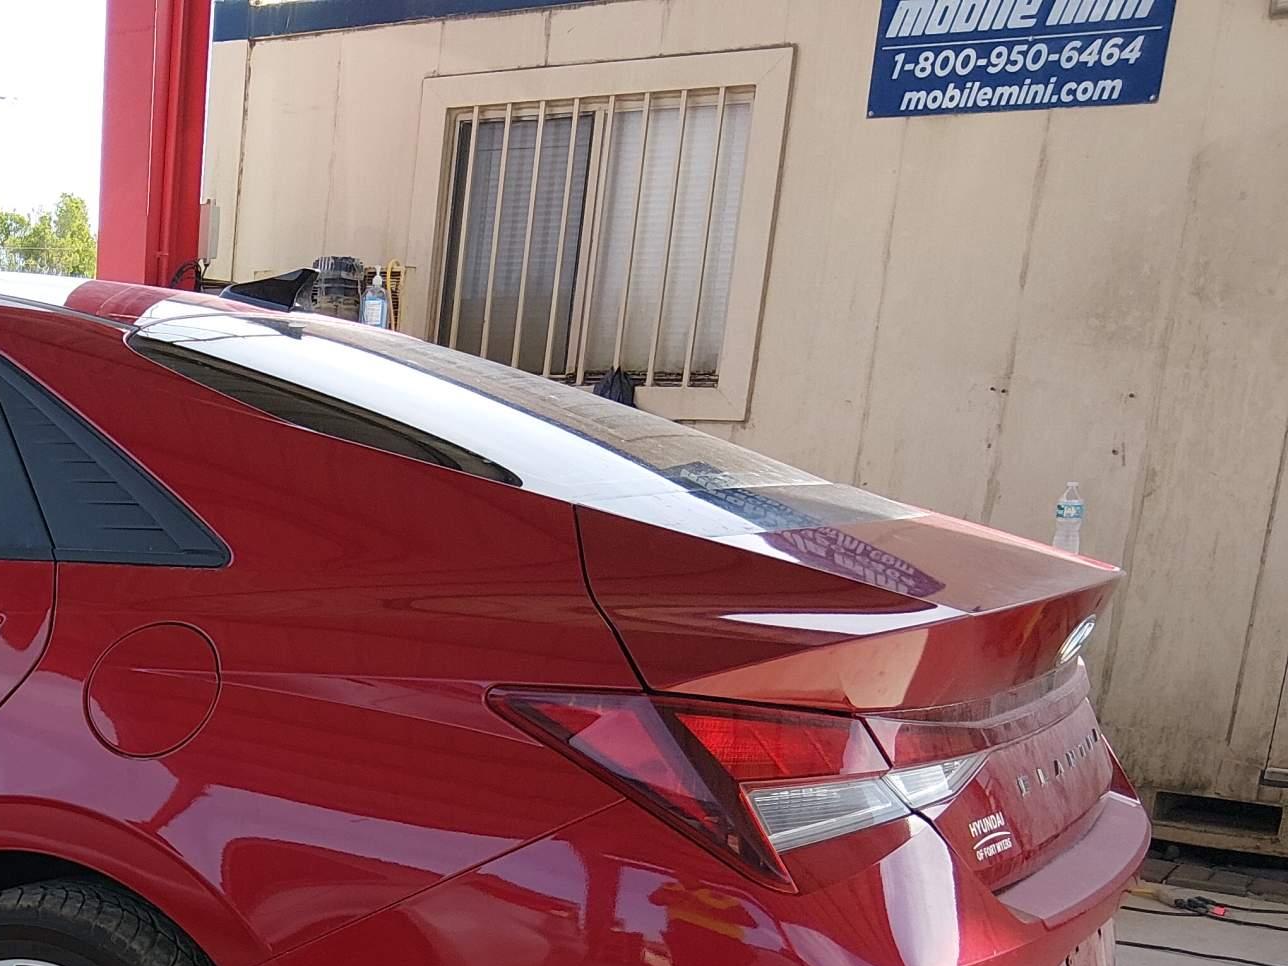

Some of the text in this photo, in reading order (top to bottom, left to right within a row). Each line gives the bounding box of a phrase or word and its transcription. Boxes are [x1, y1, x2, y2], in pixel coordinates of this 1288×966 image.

[885, 0, 1041, 38] mobile
[891, 35, 1143, 80] 1-800-950-6464
[899, 76, 1122, 111] mobilemini.com
[968, 811, 1005, 838] HYUNDAI
[976, 849, 985, 861] OF
[984, 844, 998, 858] FORT
